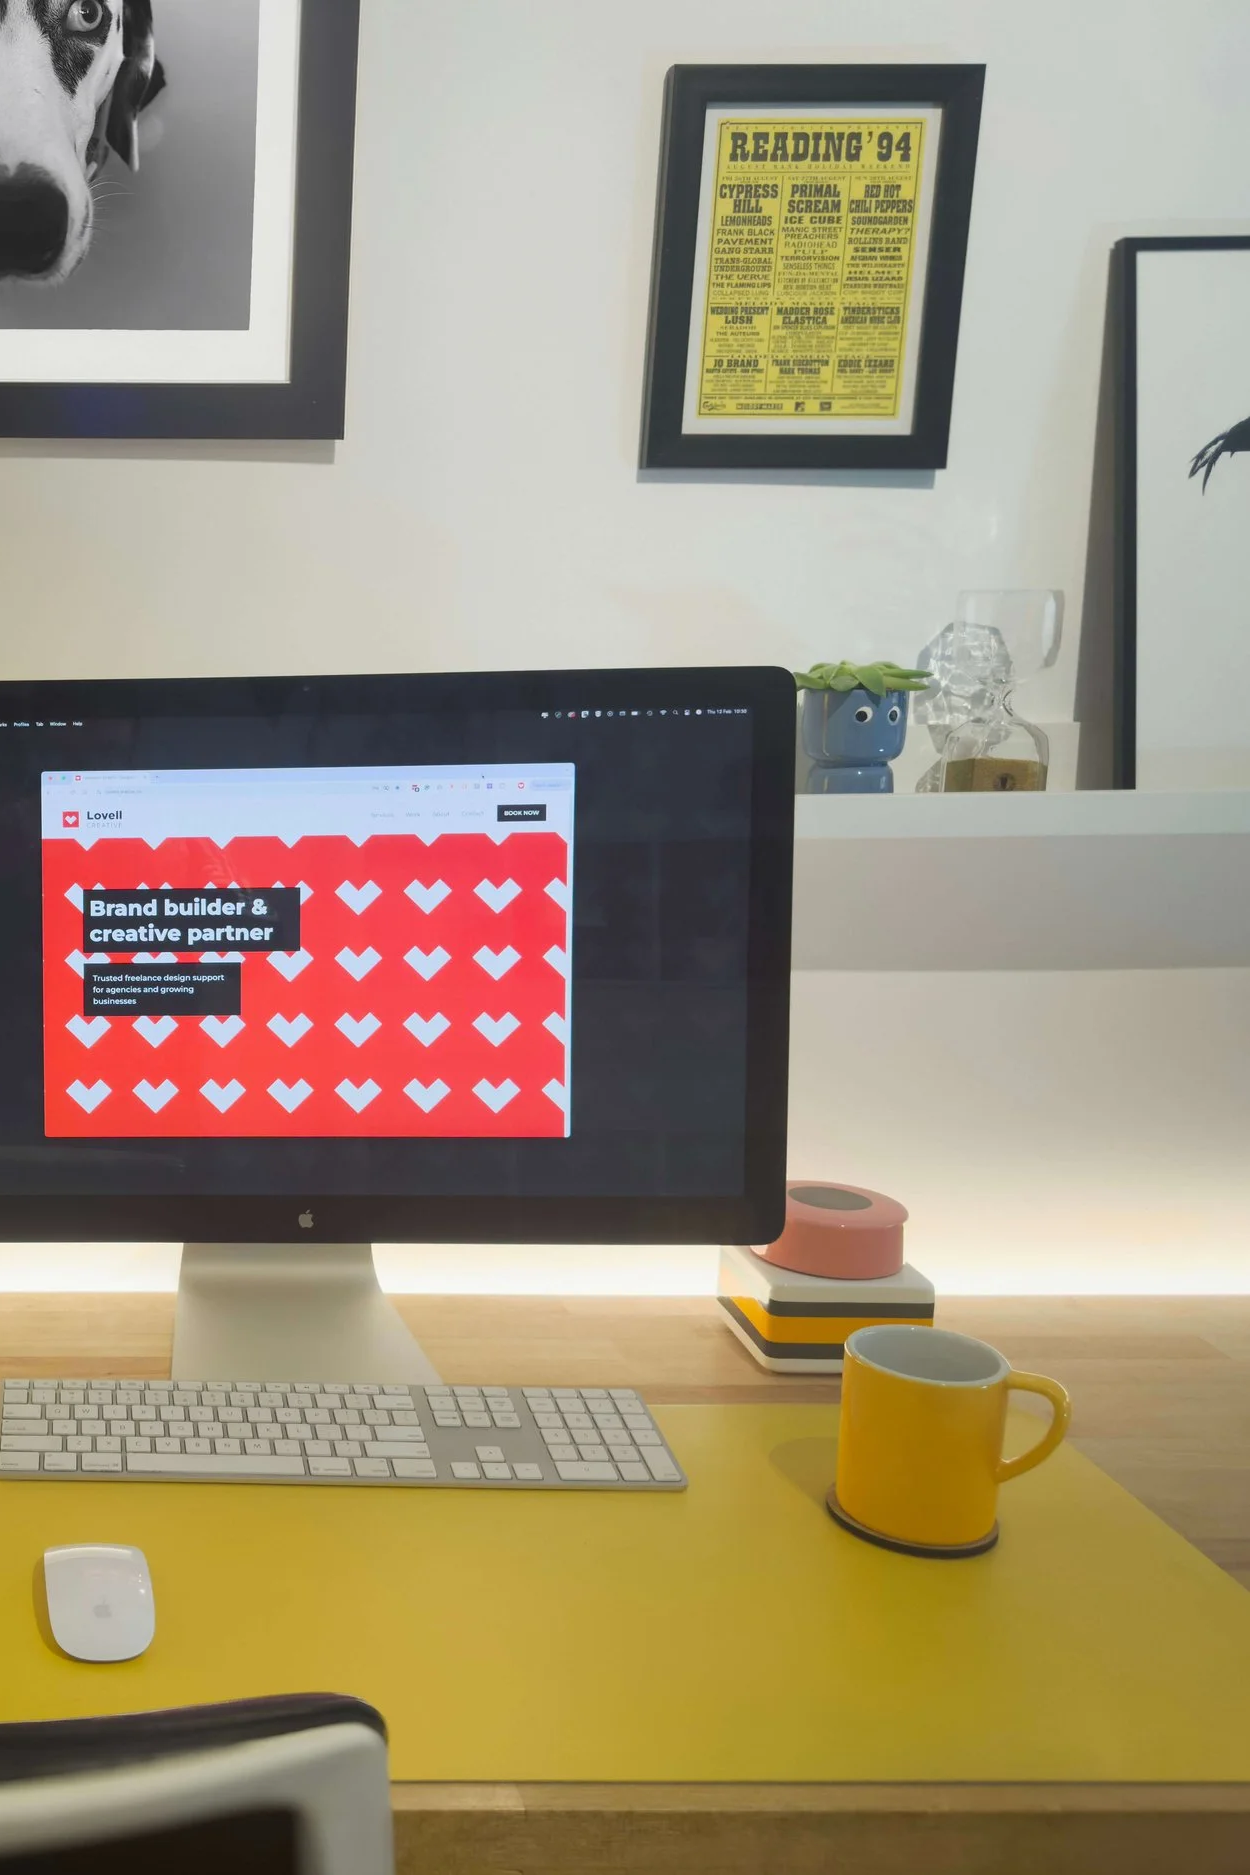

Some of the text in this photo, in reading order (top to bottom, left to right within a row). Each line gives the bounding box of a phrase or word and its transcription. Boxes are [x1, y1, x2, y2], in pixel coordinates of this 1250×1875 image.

[729, 131, 911, 162] READING '94
[719, 184, 778, 199] CYPRESS
[791, 184, 840, 198] PRIMAL
[864, 184, 901, 198] RED HOT
[733, 199, 762, 213] HILL
[787, 200, 841, 213] SCREAM
[850, 199, 913, 213] CHILI PEPPERS
[721, 216, 772, 226] LEMONHEADS
[784, 216, 842, 224] ICE CUBE
[851, 216, 908, 225] SOUNDGARDEN
[724, 316, 752, 324] LUSH
[782, 316, 827, 324] ELASTICA
[714, 359, 759, 368] JO BRAND
[86, 810, 122, 820] Lovell
[90, 898, 268, 917] Brand builder &
[90, 924, 274, 945] creative partner
[124, 974, 162, 982] freelance
[164, 974, 190, 983] design
[192, 974, 224, 983] support
[106, 986, 142, 995] agencies
[143, 985, 158, 994] and
[160, 985, 194, 995] growing
[93, 997, 137, 1005] businesses
